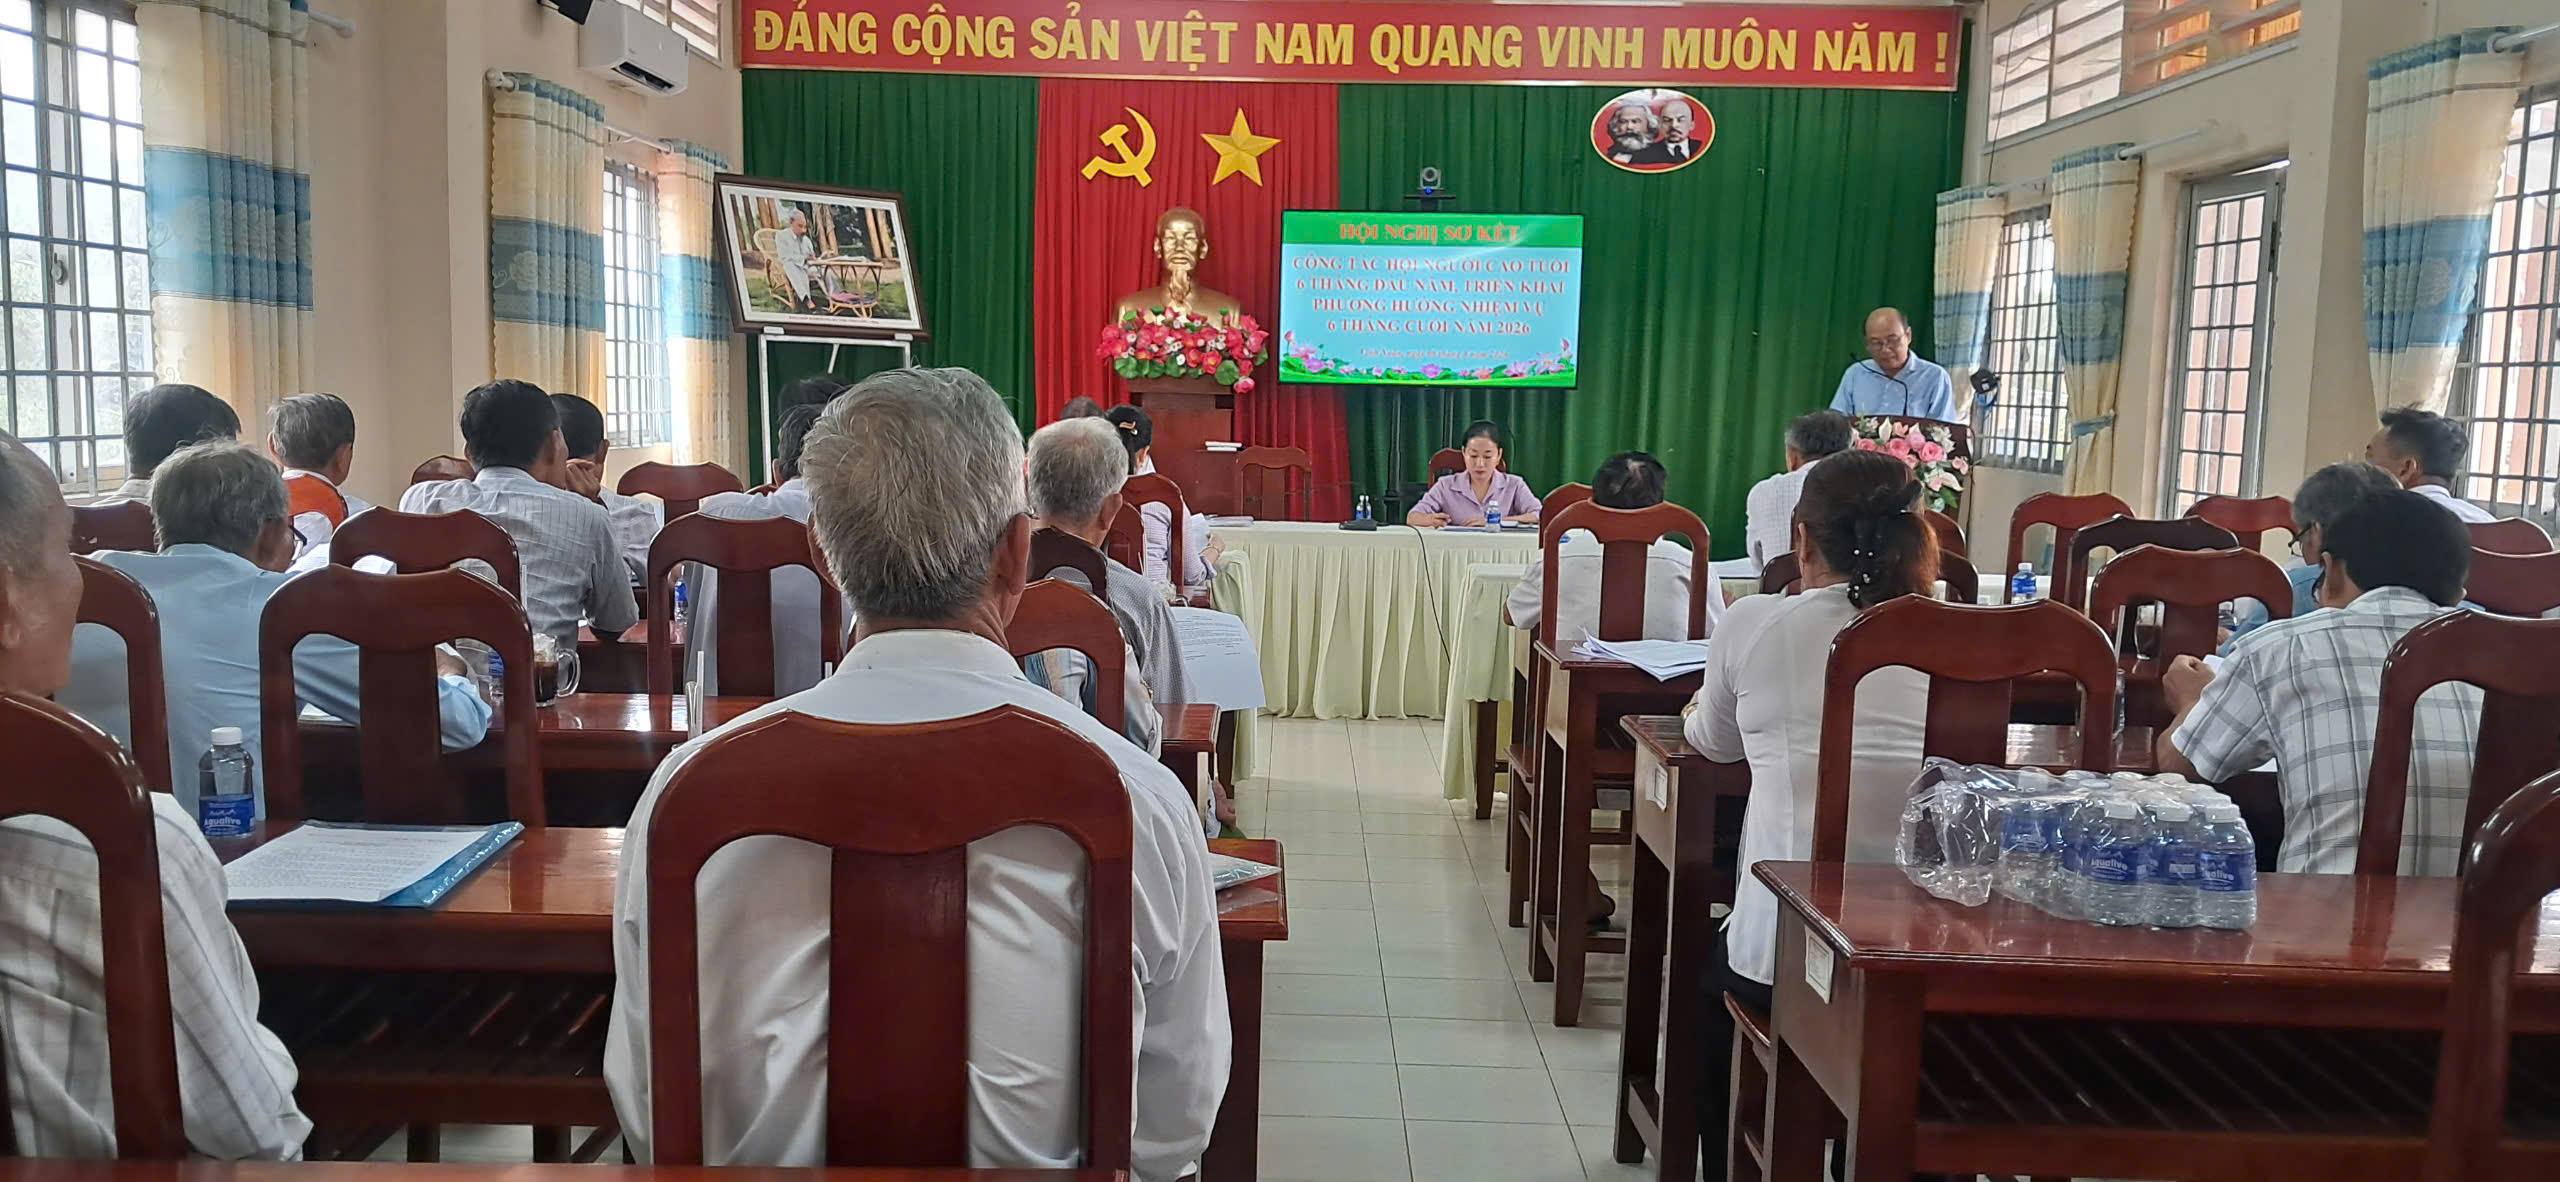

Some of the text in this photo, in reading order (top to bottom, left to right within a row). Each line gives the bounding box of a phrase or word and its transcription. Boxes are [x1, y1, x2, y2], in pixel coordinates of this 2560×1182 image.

[753, 0, 877, 54] ĐẢNG
[892, 3, 1015, 64] CỘNG
[1029, 1, 1119, 60] SẢN
[1136, 9, 1238, 72] VIỆT
[1256, 22, 1354, 65] NAM
[1370, 24, 1523, 74] QUANG
[1537, 26, 1644, 69] VINH
[1662, 17, 1797, 71] MUÔN
[1813, 23, 1915, 72] NĂM
[1339, 219, 1520, 246] HỘI NGHỊ SƠ KẾT
[1293, 251, 1342, 270] CÔNG
[1347, 253, 1377, 270] TÁC
[1386, 254, 1418, 274] HỘI
[1422, 255, 1481, 273] NGƯỜI
[1485, 257, 1524, 272] CAO
[1297, 278, 1305, 290] 6
[1311, 274, 1369, 290] THÁNG
[1520, 279, 1565, 293] KHAI
[1313, 296, 1387, 312] PHƯƠNG
[1391, 296, 1455, 312] HƯỚNG
[1461, 298, 1519, 317] NHIỆM
[1328, 319, 1336, 332] 6
[1341, 315, 1399, 332] THÁNG
[1455, 318, 1492, 334] NĂM
[1497, 321, 1531, 335] 2026
